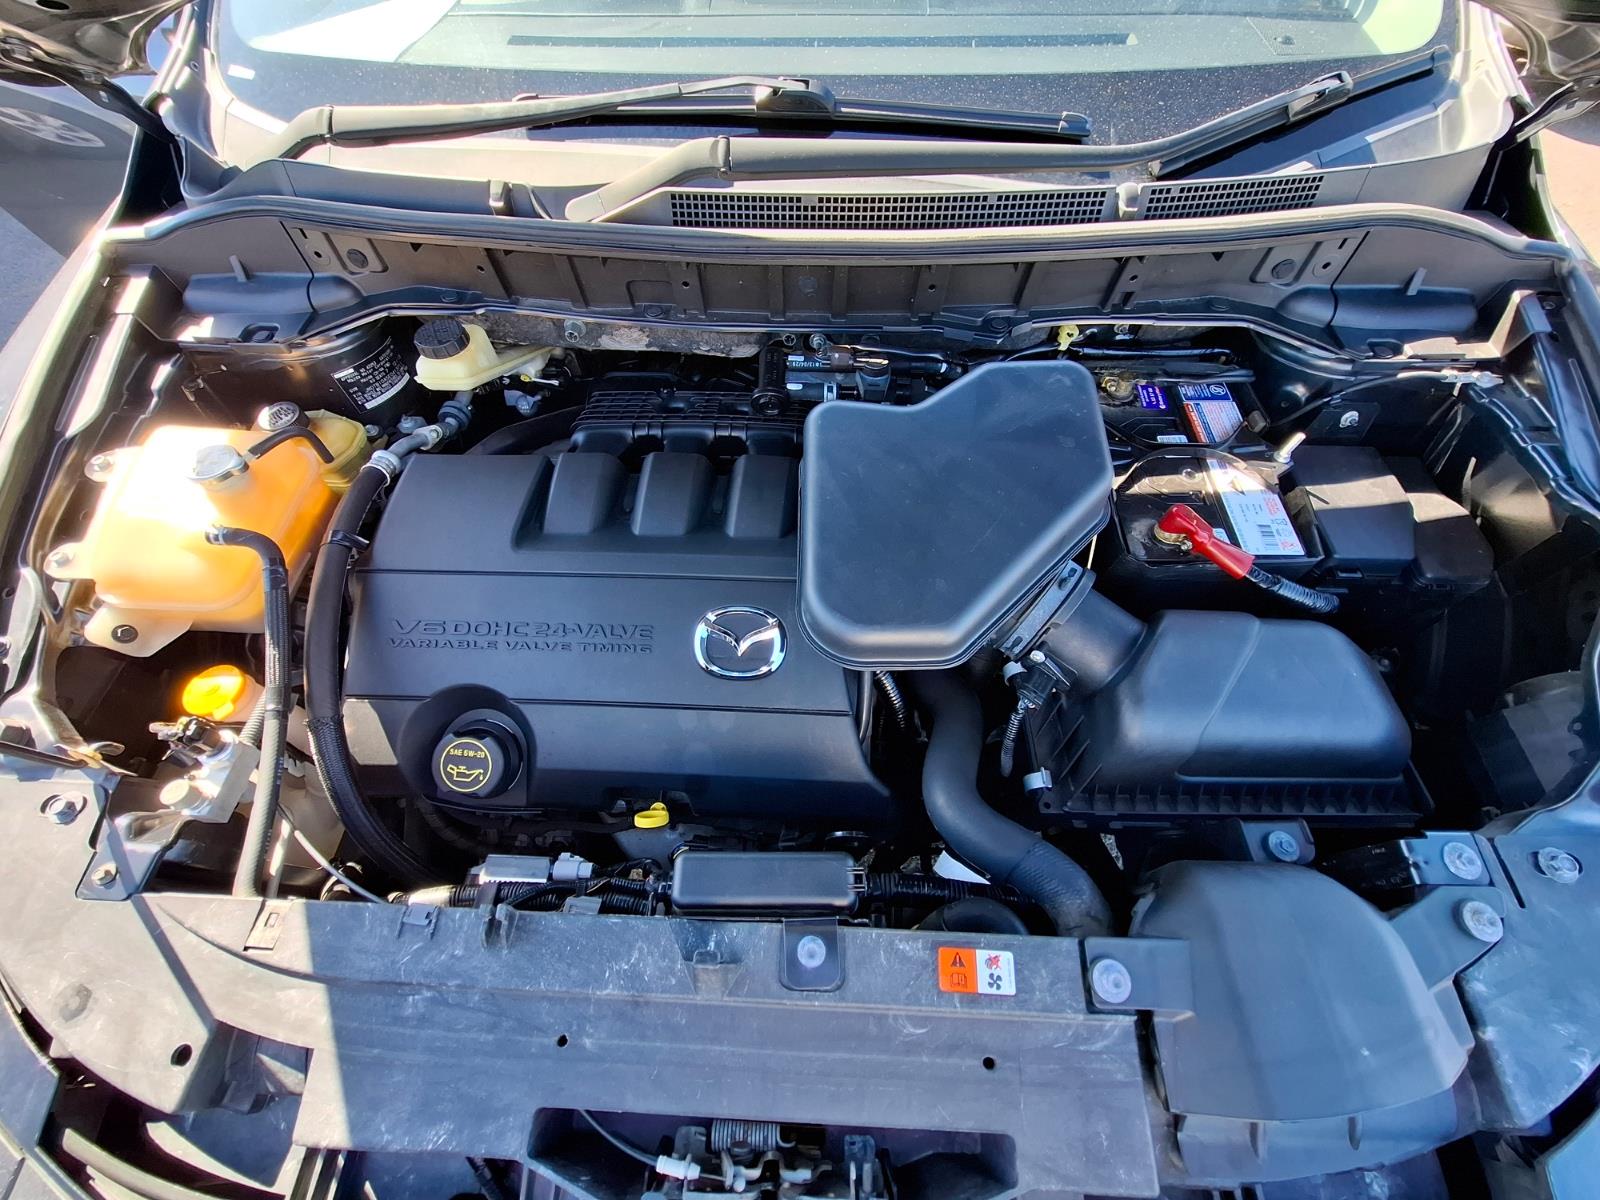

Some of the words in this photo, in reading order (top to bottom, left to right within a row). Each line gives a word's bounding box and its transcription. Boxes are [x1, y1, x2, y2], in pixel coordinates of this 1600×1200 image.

[393, 619, 446, 635] V6
[449, 621, 529, 638] DOHC
[533, 622, 655, 642] 24-VALVE
[388, 637, 498, 650] VARIABLE
[505, 640, 572, 652] VALVE
[576, 641, 654, 654] TIMING
[449, 748, 463, 756] SAE
